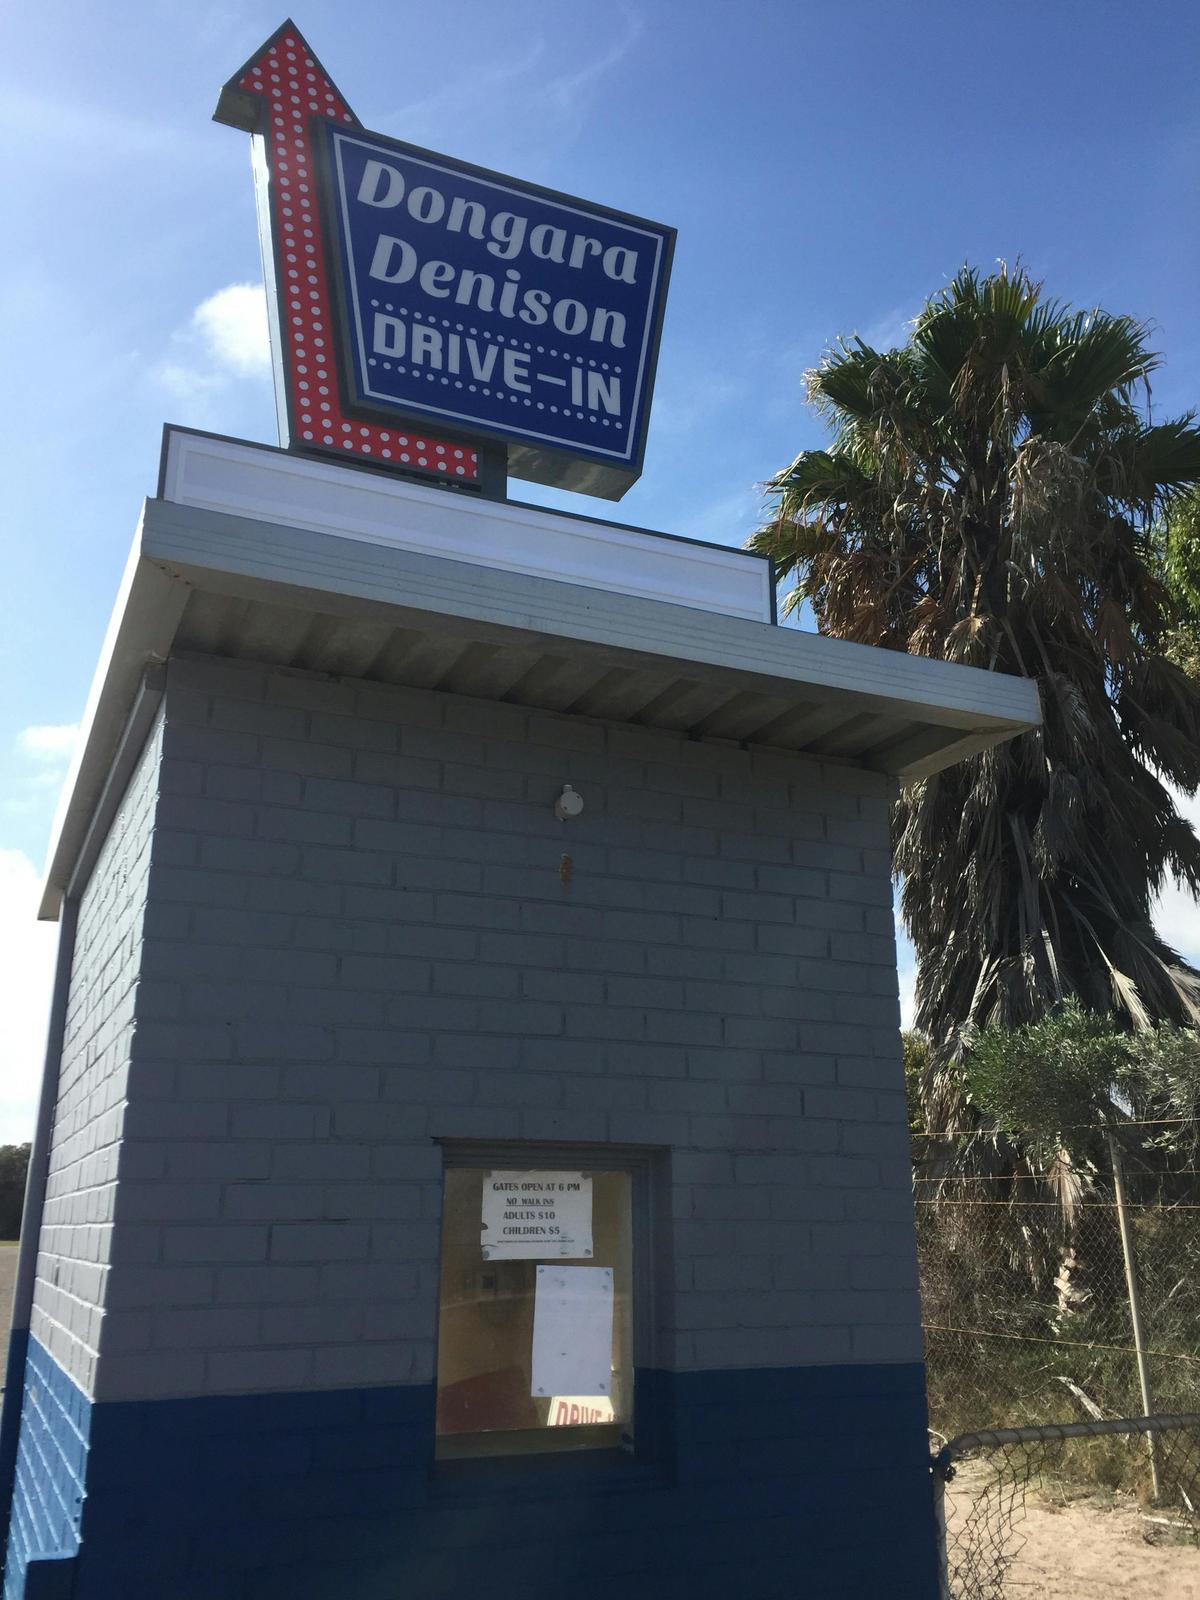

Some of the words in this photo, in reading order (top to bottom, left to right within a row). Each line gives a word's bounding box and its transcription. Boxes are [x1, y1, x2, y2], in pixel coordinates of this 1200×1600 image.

[357, 159, 639, 285] Dongara
[369, 234, 626, 348] Denison
[373, 312, 621, 416] DRIVE-IN
[492, 1182, 519, 1192] GATES
[521, 1182, 544, 1192] OPEN
[545, 1183, 556, 1192] AT
[558, 1183, 565, 1192] 6
[566, 1183, 580, 1192] PM
[503, 1211, 536, 1220] ADULTS
[538, 1211, 556, 1220] $10
[502, 1226, 546, 1235] CHILDREN
[548, 1226, 560, 1235] $5
